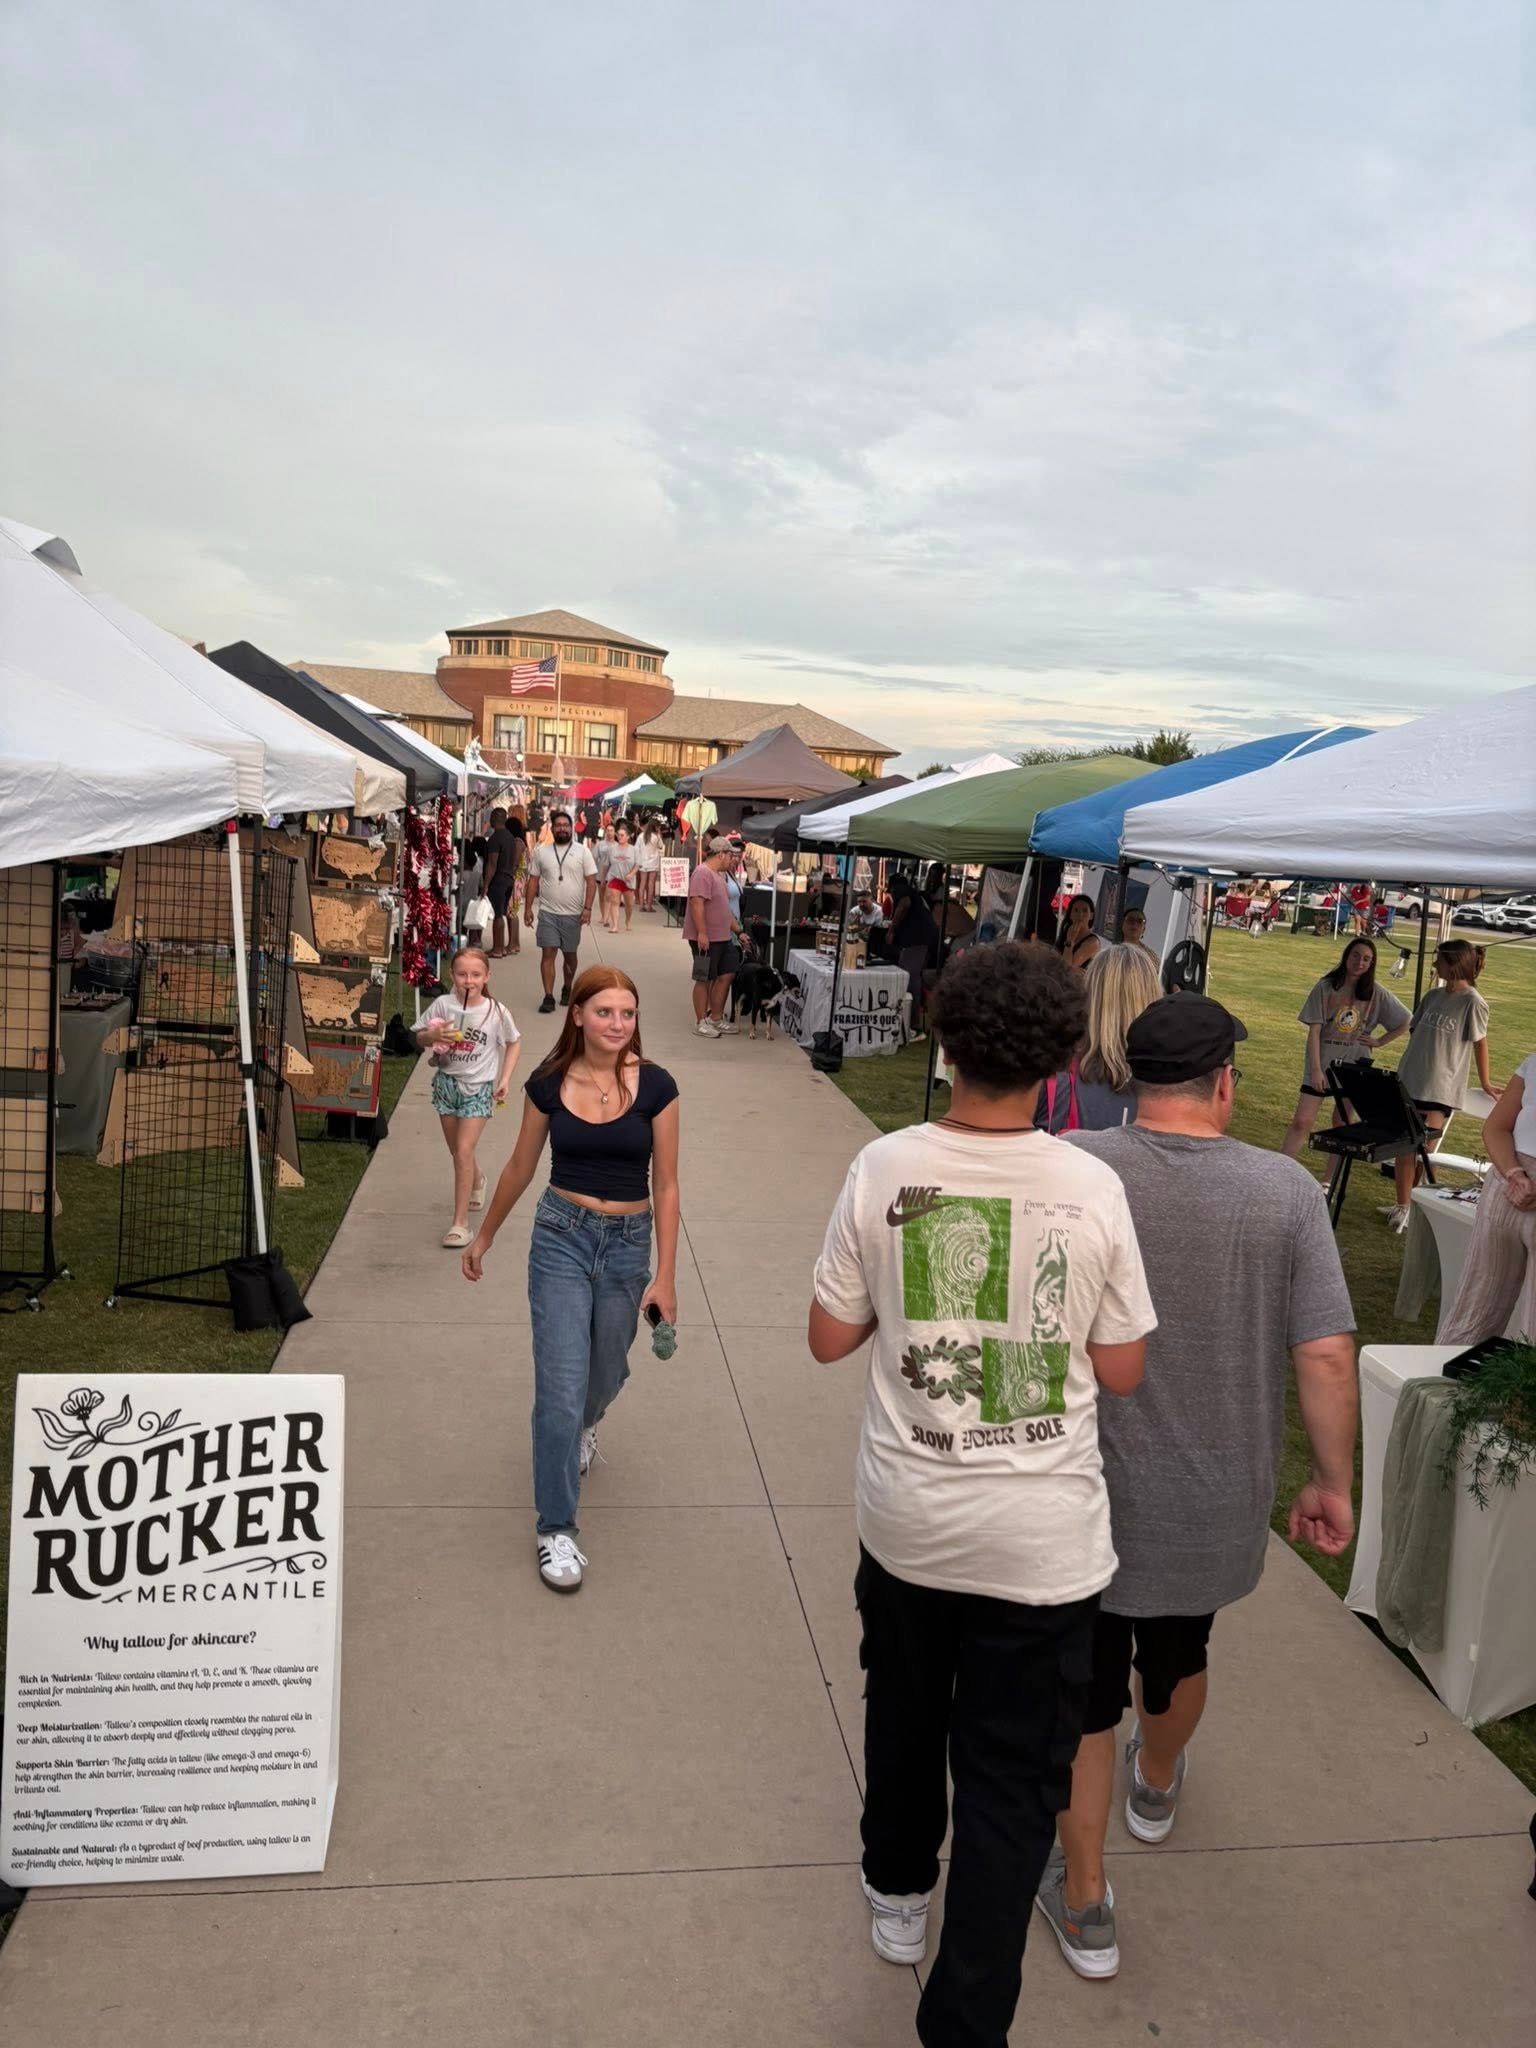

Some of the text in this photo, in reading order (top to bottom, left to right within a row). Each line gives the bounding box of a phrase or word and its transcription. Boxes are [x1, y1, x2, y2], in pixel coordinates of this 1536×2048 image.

[561, 707, 602, 716] MELISSA
[834, 1014, 896, 1027] FRAZIER'S QUE
[894, 1186, 942, 1209] NIKE
[911, 1425, 954, 1452] SLOW
[1026, 1418, 1066, 1442] SOLE
[22, 1412, 329, 1520] MOTHER
[31, 1481, 325, 1600] RUCKER
[137, 1581, 326, 1603] MERCANTILE
[84, 1631, 257, 1652] Why tallow for skincare?
[19, 1674, 38, 1683] Rich
[41, 1674, 49, 1683] in
[51, 1673, 93, 1682] Nutrients:
[95, 1671, 121, 1681] Tallow
[123, 1671, 155, 1679] contains
[157, 1669, 189, 1678] vitamins
[222, 1667, 237, 1676] and
[250, 1665, 271, 1674] These
[274, 1665, 304, 1673] vitamins
[18, 1686, 50, 1696] essential
[52, 1686, 63, 1697] for
[66, 1684, 112, 1695] maintaining
[115, 1683, 130, 1692] skin
[161, 1682, 175, 1690] and
[178, 1681, 193, 1691] they
[195, 1680, 211, 1690] help
[213, 1679, 242, 1690] promote
[282, 1677, 312, 1687] glowing
[17, 1723, 38, 1733] Deep
[184, 1717, 208, 1727] closely
[211, 1715, 246, 1724] resembles
[248, 1714, 260, 1722] the
[262, 1713, 289, 1722] natural
[305, 1712, 312, 1720] in
[17, 1737, 29, 1745] our
[52, 1734, 84, 1745] allowing
[87, 1733, 92, 1742] it
[94, 1733, 101, 1742] to
[104, 1731, 129, 1741] absorb
[131, 1731, 155, 1741] deeply
[157, 1729, 172, 1738] and
[212, 1728, 239, 1737] without
[241, 1727, 273, 1737] clogging
[16, 1760, 52, 1771] Supports
[54, 1759, 73, 1768] Skin
[112, 1756, 126, 1766] The
[128, 1755, 145, 1767] fatty
[148, 1755, 168, 1764] acids
[170, 1754, 176, 1762] in
[179, 1753, 202, 1762] tallow
[258, 1750, 272, 1759] and
[15, 1774, 31, 1783] help
[33, 1772, 72, 1782] strengthen
[75, 1771, 87, 1779] the
[89, 1770, 104, 1779] skin
[137, 1768, 175, 1778] increasing
[213, 1765, 228, 1773] and
[230, 1763, 258, 1773] keeping
[294, 1761, 301, 1769] in
[303, 1760, 318, 1769] and
[140, 1804, 166, 1813] Tallow
[168, 1804, 182, 1813] can
[184, 1803, 199, 1812] help
[201, 1802, 226, 1811] reduce
[281, 1797, 309, 1808] making
[311, 1797, 316, 1805] it
[13, 1822, 44, 1832] soothing
[46, 1821, 57, 1832] for
[60, 1820, 98, 1829] conditions
[100, 1819, 113, 1828] like
[116, 1819, 143, 1827] eczema
[155, 1818, 169, 1827] dry
[12, 1846, 60, 1857] Sustainable
[62, 1845, 79, 1854] and
[178, 1839, 186, 1851] of
[187, 1838, 202, 1850] beef
[247, 1836, 267, 1846] using
[268, 1836, 291, 1844] tallow
[293, 1835, 298, 1843] is
[301, 1835, 310, 1843] an
[86, 1856, 113, 1867] helping
[115, 1856, 122, 1864] to
